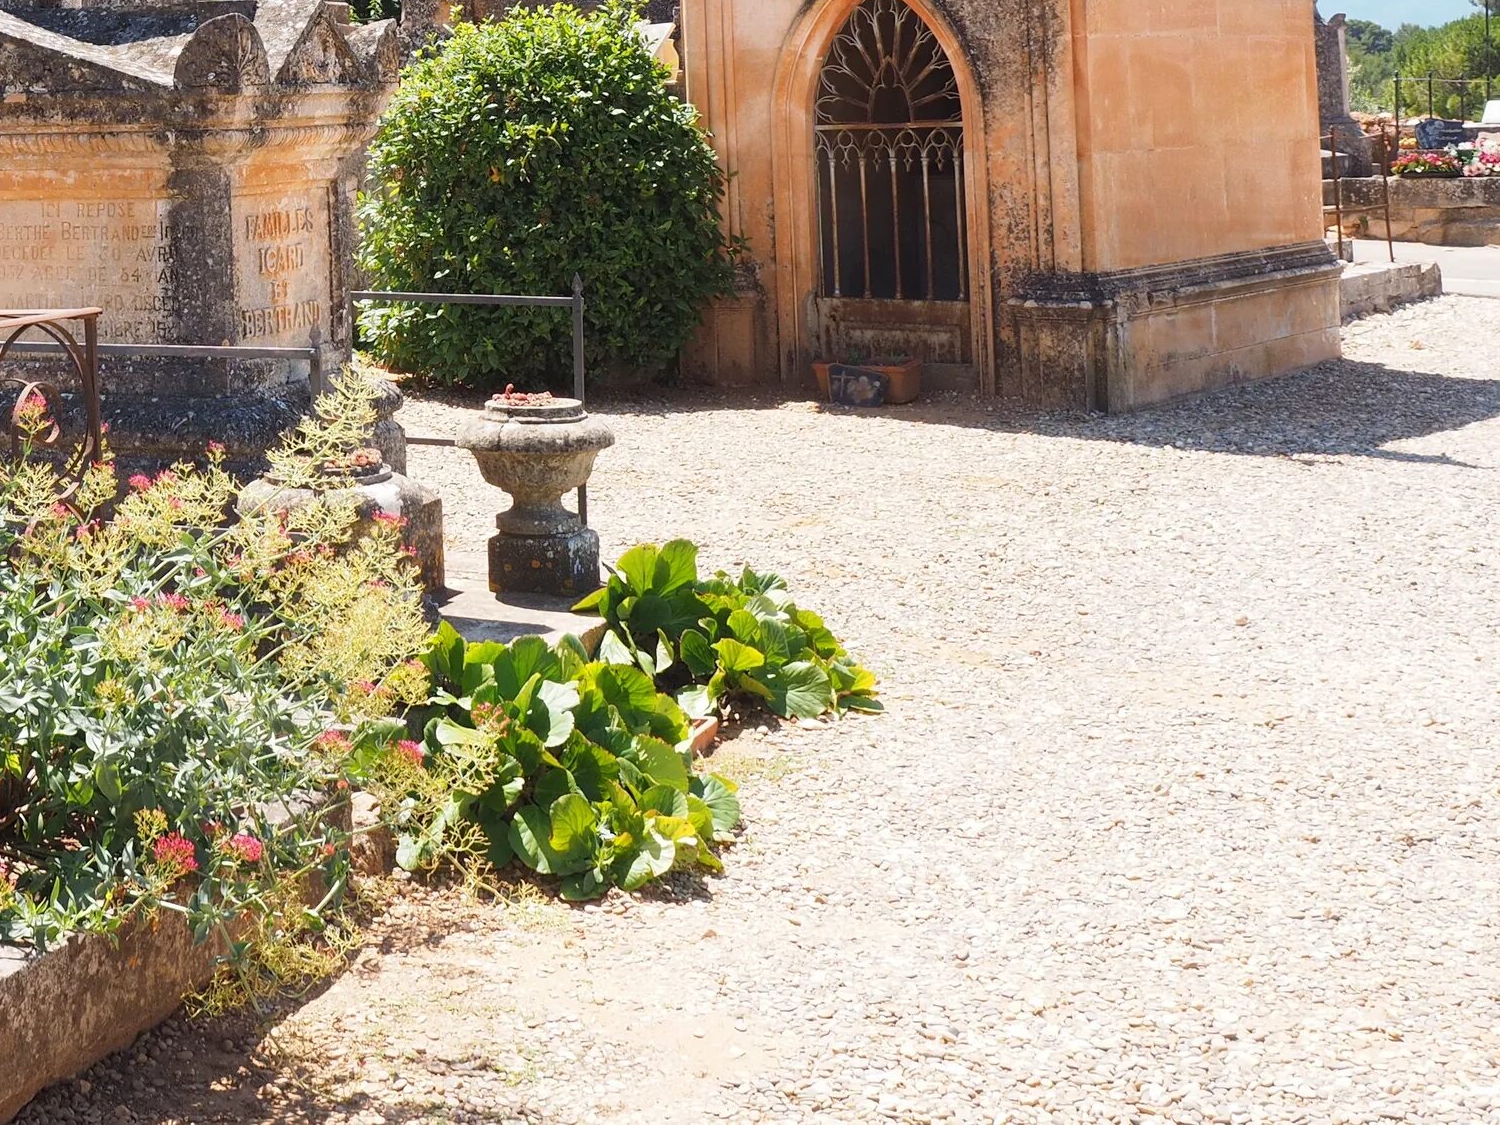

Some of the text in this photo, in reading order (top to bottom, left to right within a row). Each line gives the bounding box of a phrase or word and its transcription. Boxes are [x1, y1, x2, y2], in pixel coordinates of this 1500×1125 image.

[41, 201, 136, 218] ICI REPOSE
[61, 221, 139, 241] BERTRAND
[245, 208, 315, 240] FAMILLES
[66, 245, 86, 261] LE
[259, 243, 304, 275] ICARD
[87, 266, 111, 282] DE
[270, 278, 289, 305] ET
[242, 300, 321, 340] BERTRAND
